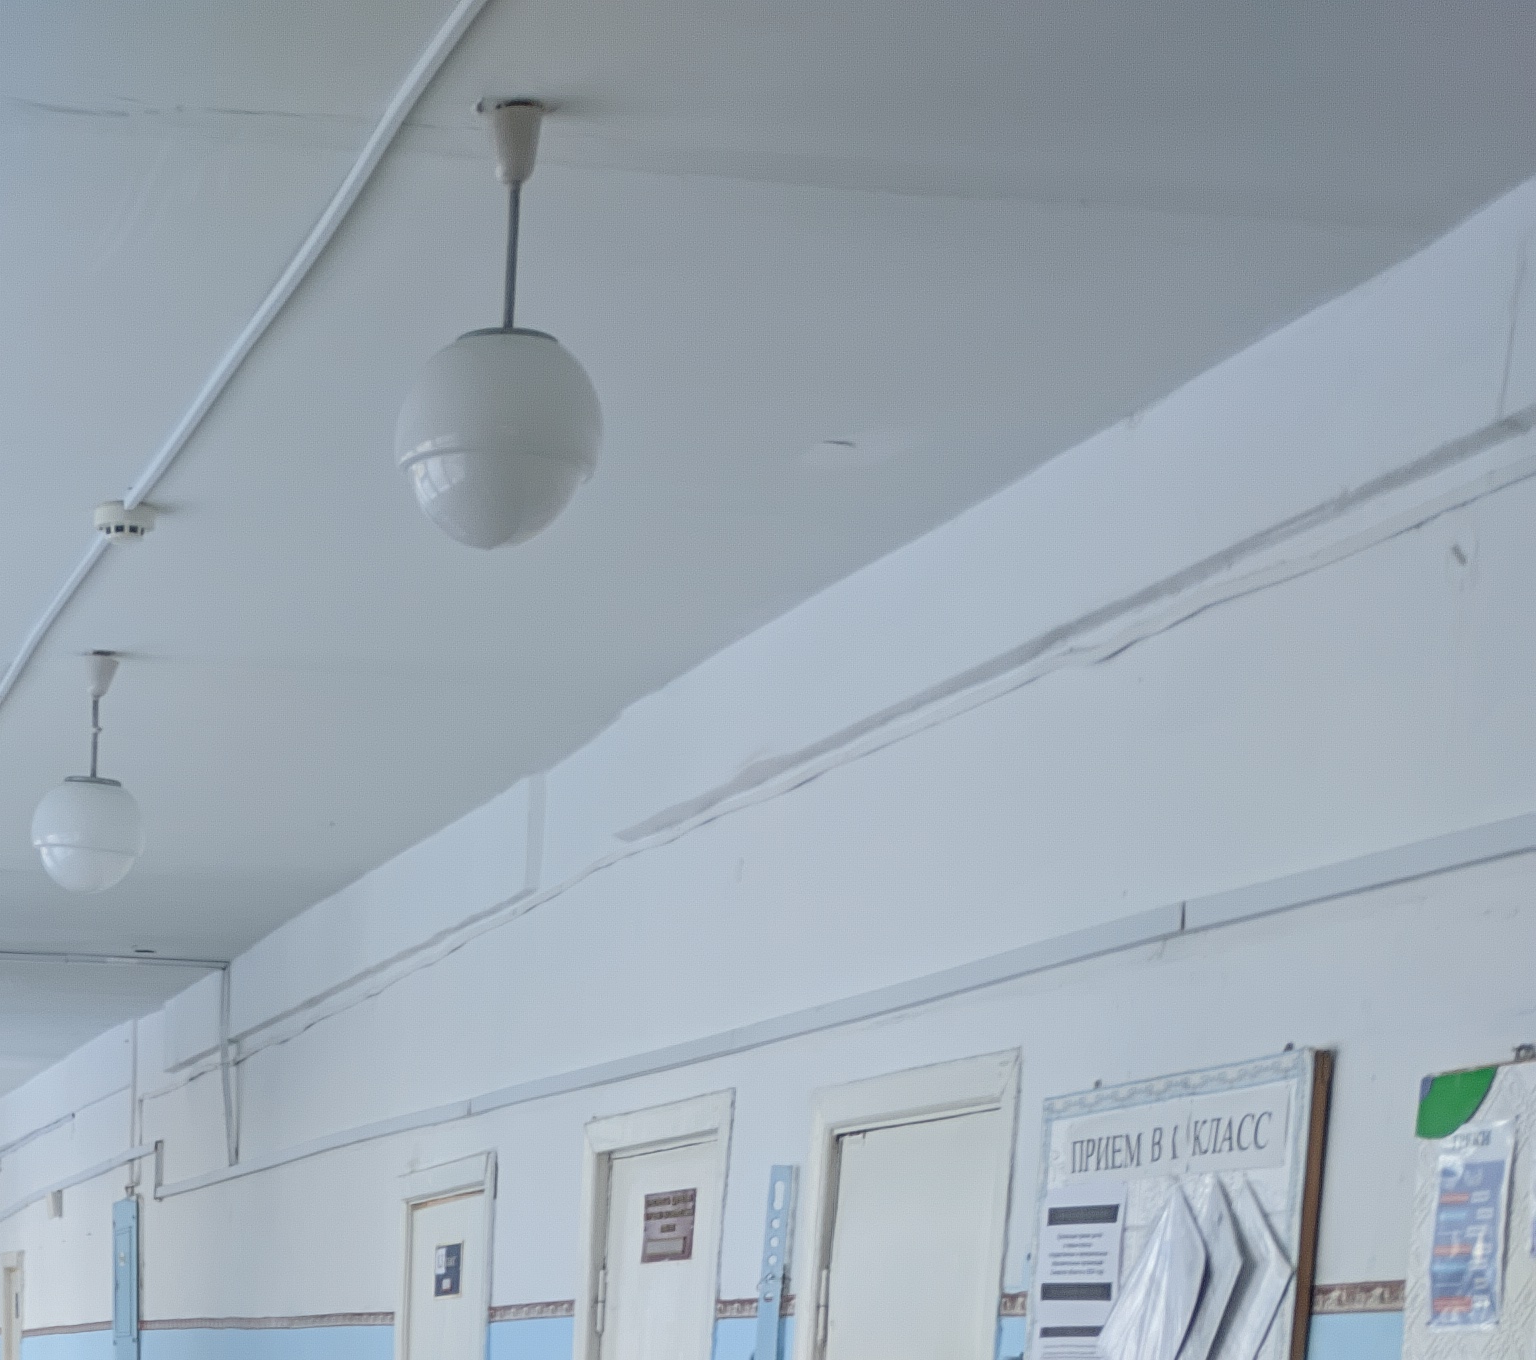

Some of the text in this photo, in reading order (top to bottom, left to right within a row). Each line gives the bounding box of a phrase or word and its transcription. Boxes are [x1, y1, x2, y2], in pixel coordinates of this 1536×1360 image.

[1070, 1132, 1144, 1174] ПРИЕМ
[1150, 1126, 1164, 1163] В
[1191, 1111, 1273, 1157] КЛАСС
